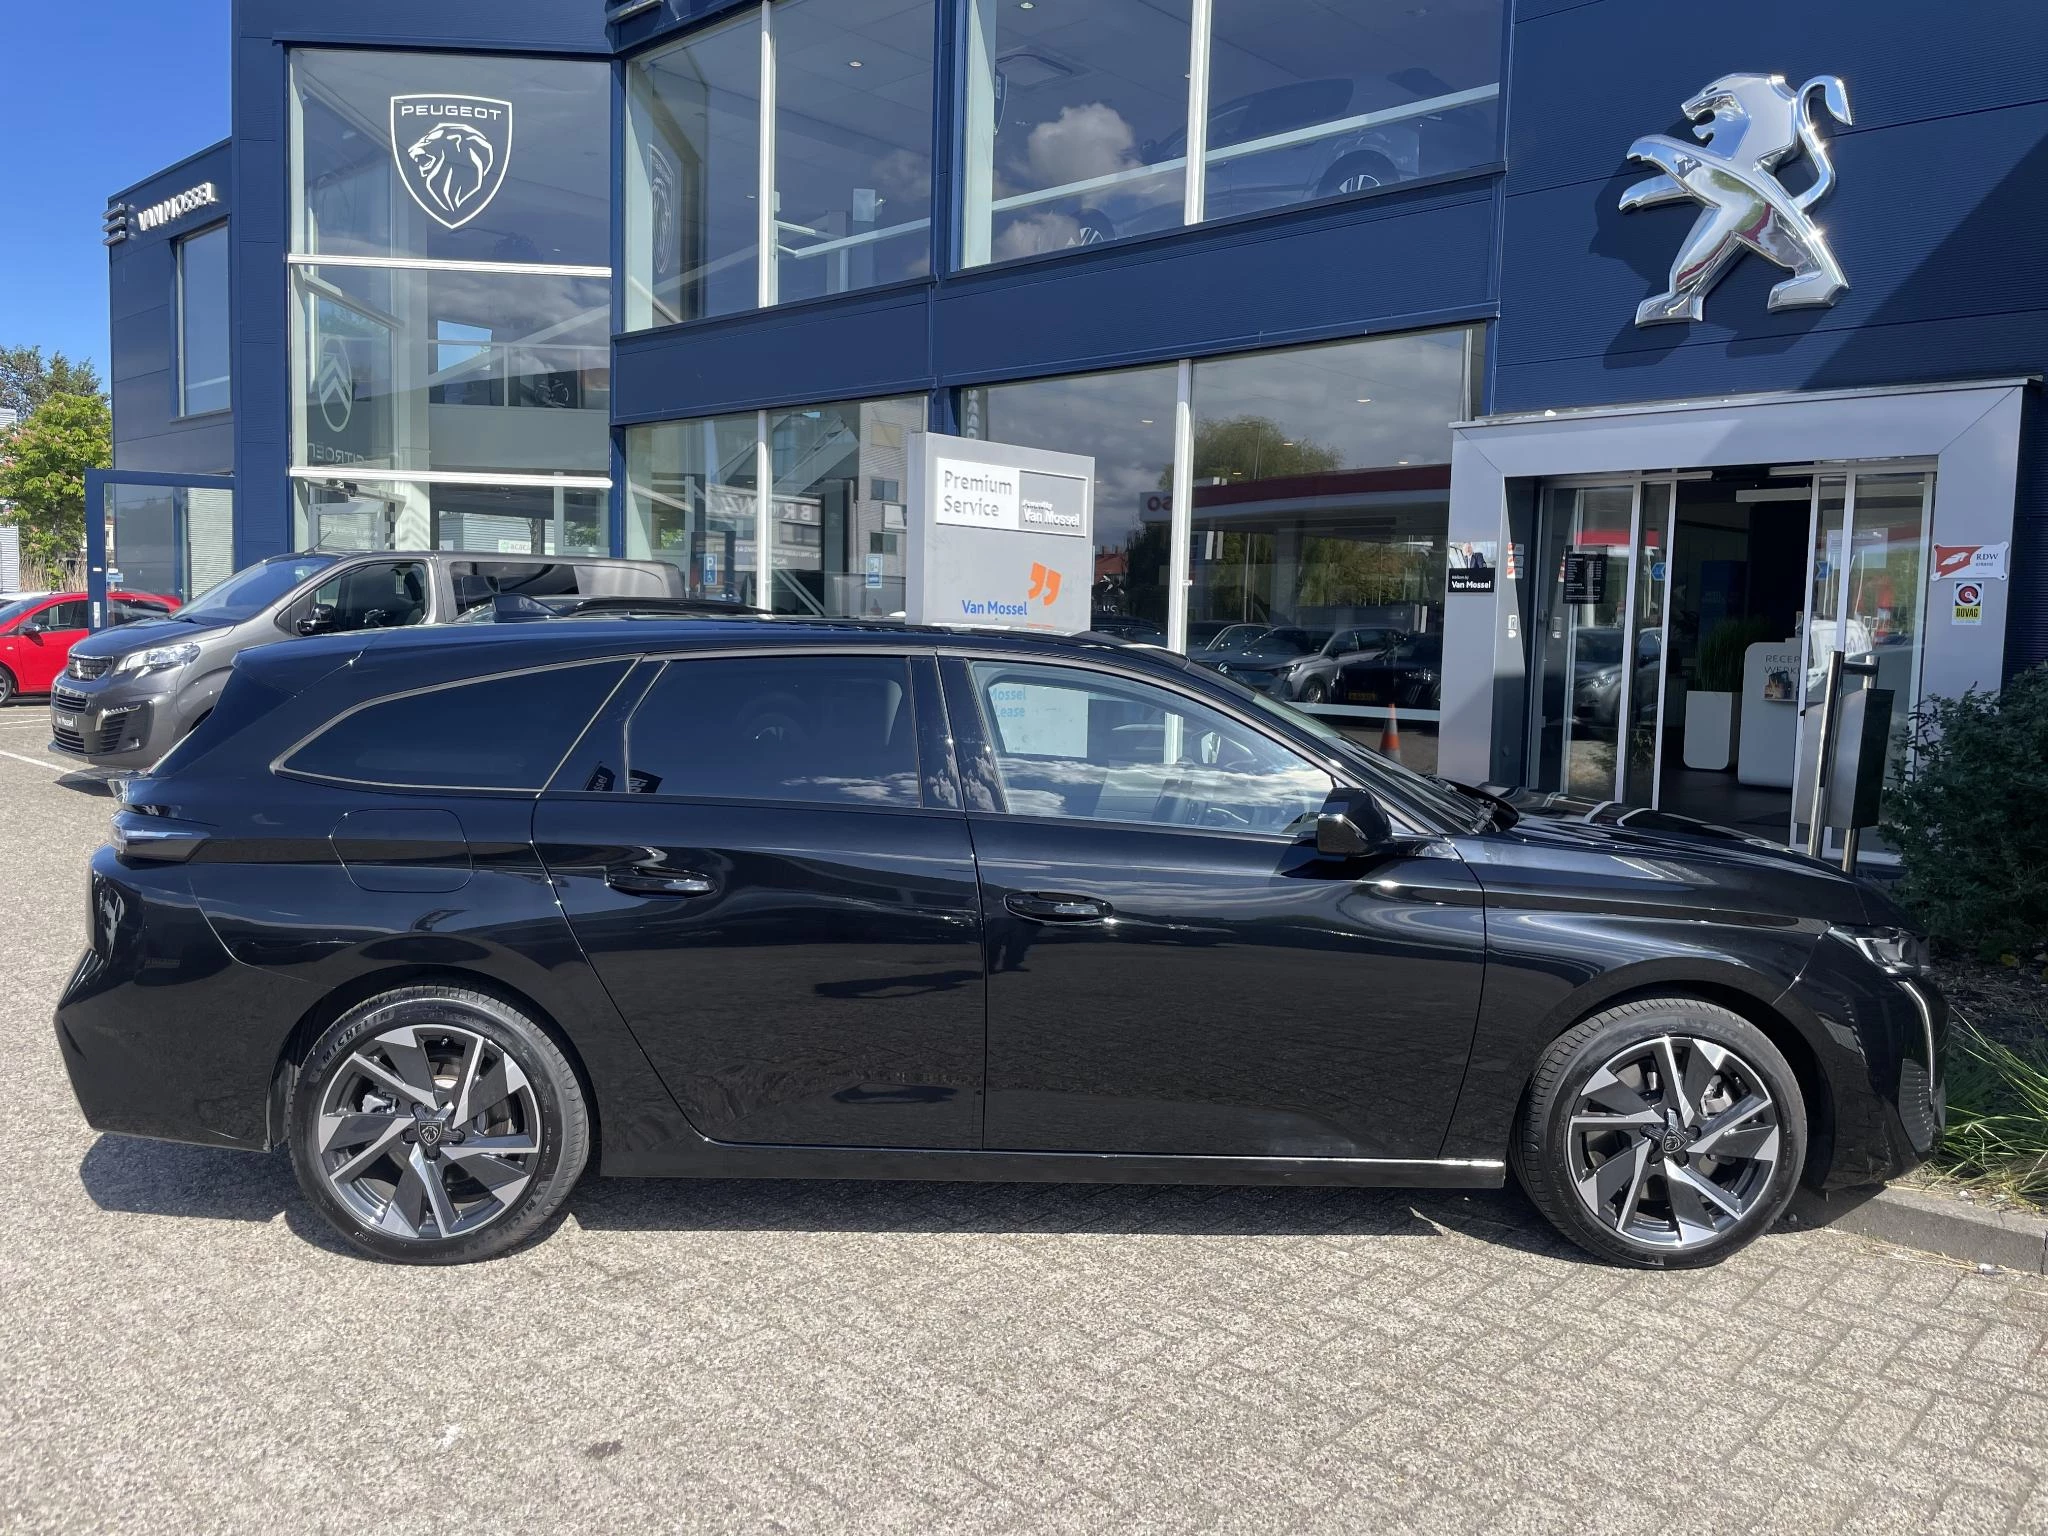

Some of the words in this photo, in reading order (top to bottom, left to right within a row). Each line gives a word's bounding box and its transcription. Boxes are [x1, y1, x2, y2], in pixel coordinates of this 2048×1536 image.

[401, 104, 502, 121] PEUGEOT
[943, 469, 1013, 496] Premium
[943, 494, 1000, 517] Service
[1023, 508, 1043, 523] Van
[1044, 510, 1080, 527] Mossel
[1975, 553, 1999, 561] RDW
[1451, 580, 1465, 589] Van
[1466, 580, 1491, 589] Mossel
[961, 600, 985, 614] Van
[987, 601, 1028, 616] Mossel
[1765, 654, 1800, 664] RECEP
